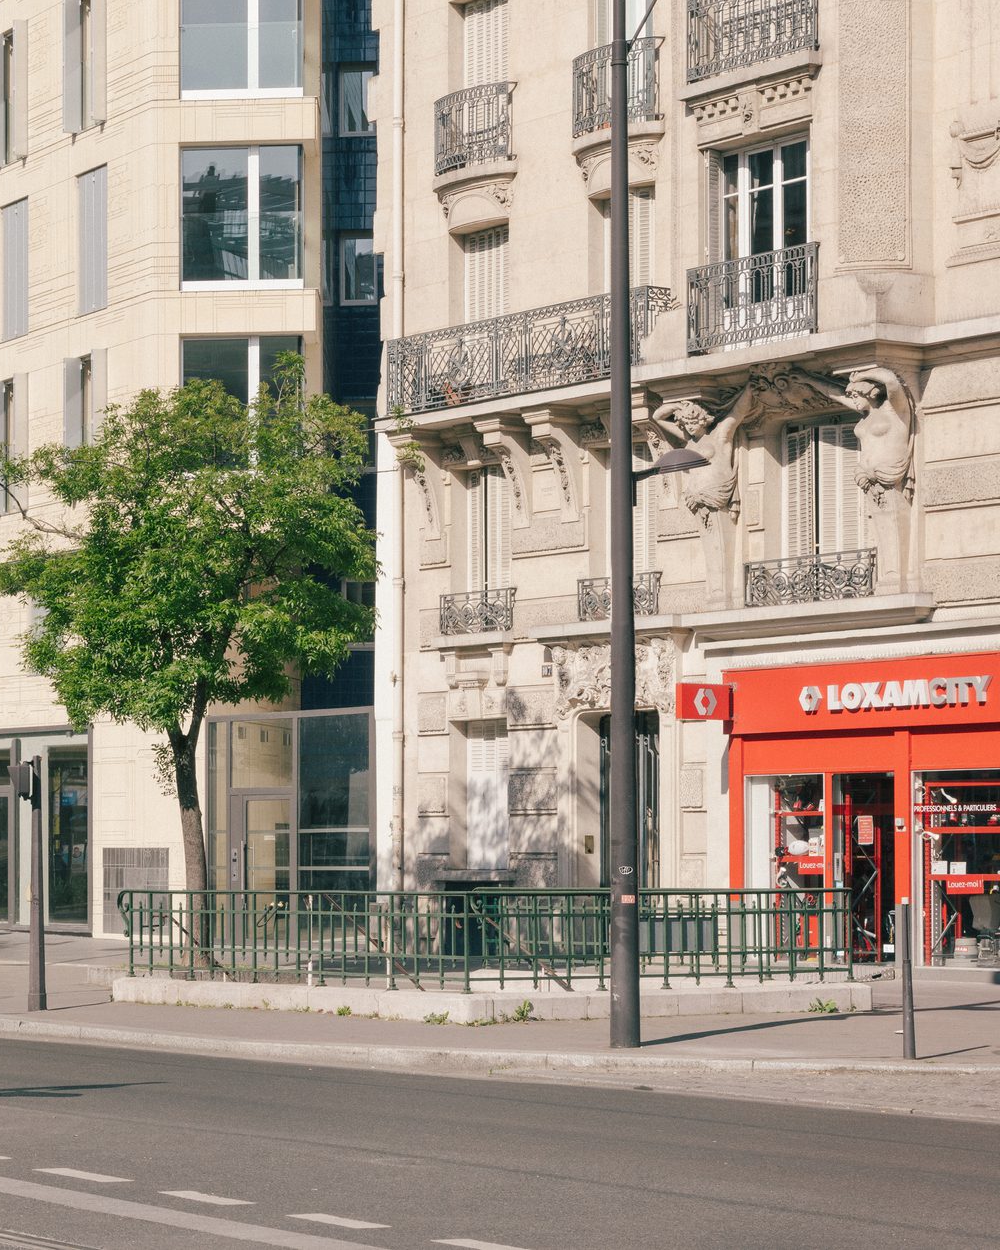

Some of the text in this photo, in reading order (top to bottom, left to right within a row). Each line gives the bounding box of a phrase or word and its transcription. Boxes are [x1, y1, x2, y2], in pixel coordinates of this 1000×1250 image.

[827, 675, 991, 711] LOXAMCITY
[913, 803, 997, 812] PROFESSIONNELS & PARTICULIERS
